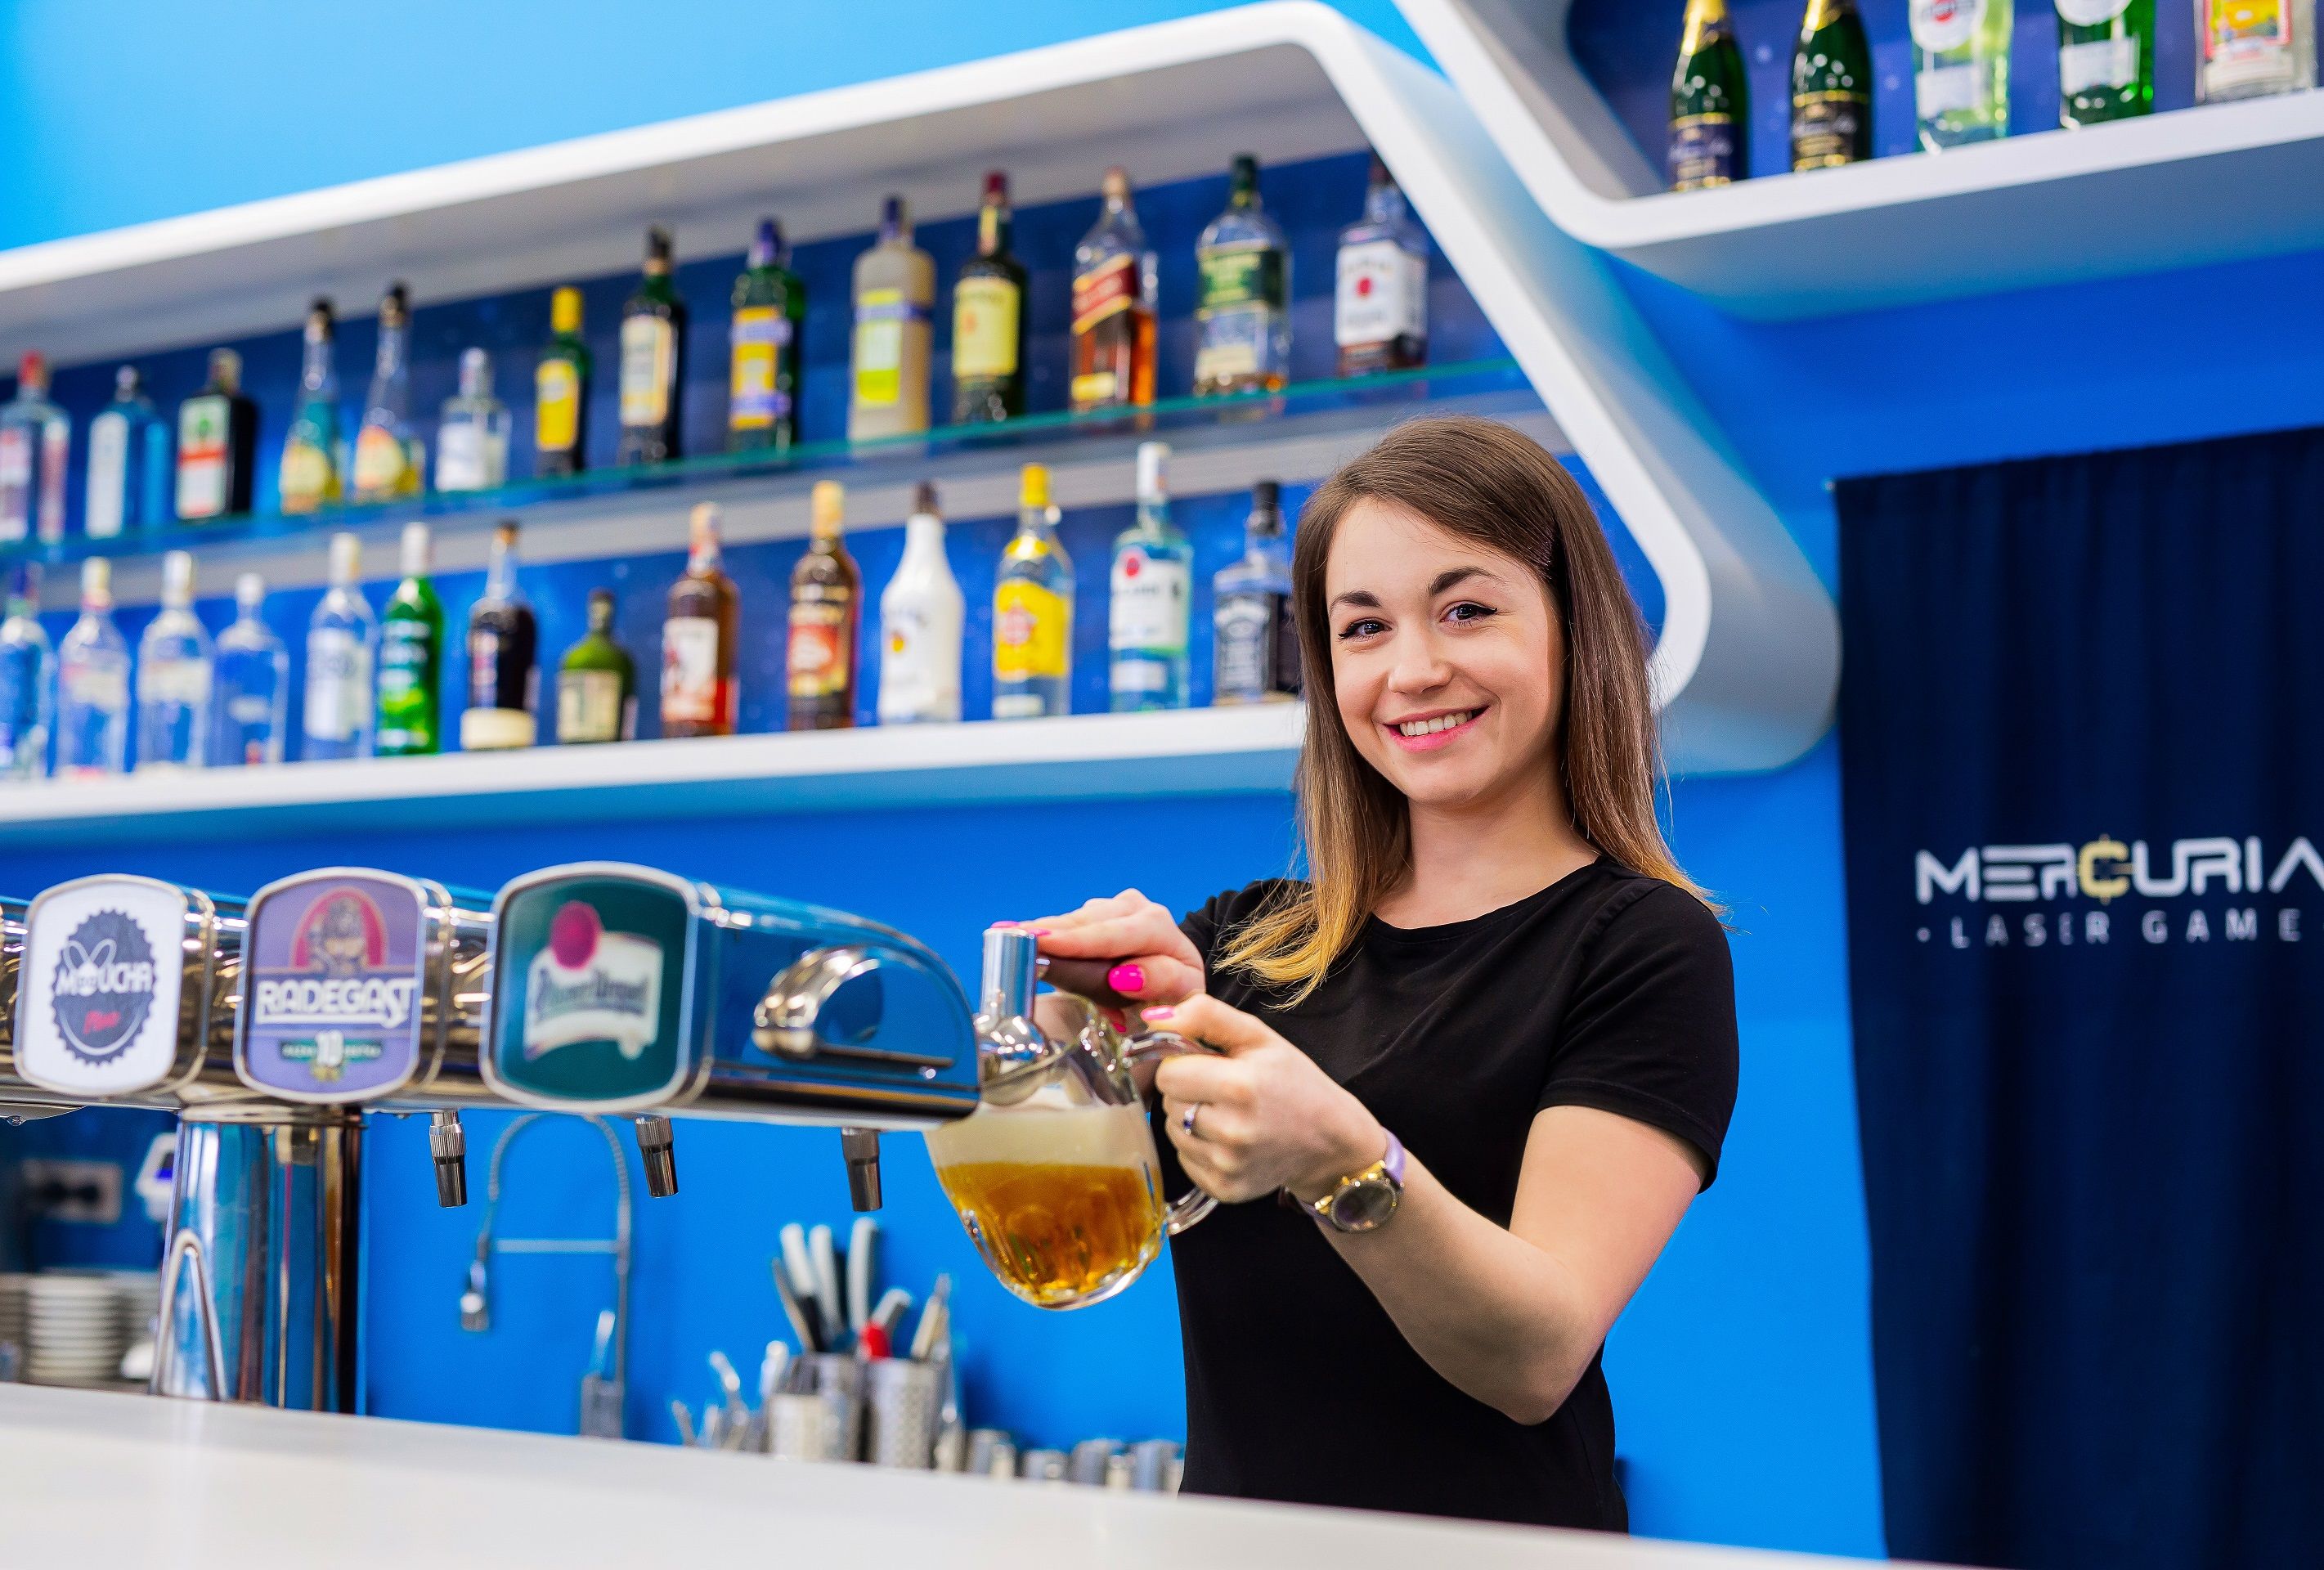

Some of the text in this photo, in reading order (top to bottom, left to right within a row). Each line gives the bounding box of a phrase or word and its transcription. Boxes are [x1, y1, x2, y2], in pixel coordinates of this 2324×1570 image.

[1950, 908, 2301, 949] LASER GAME
[255, 978, 419, 1028] RADEGAST
